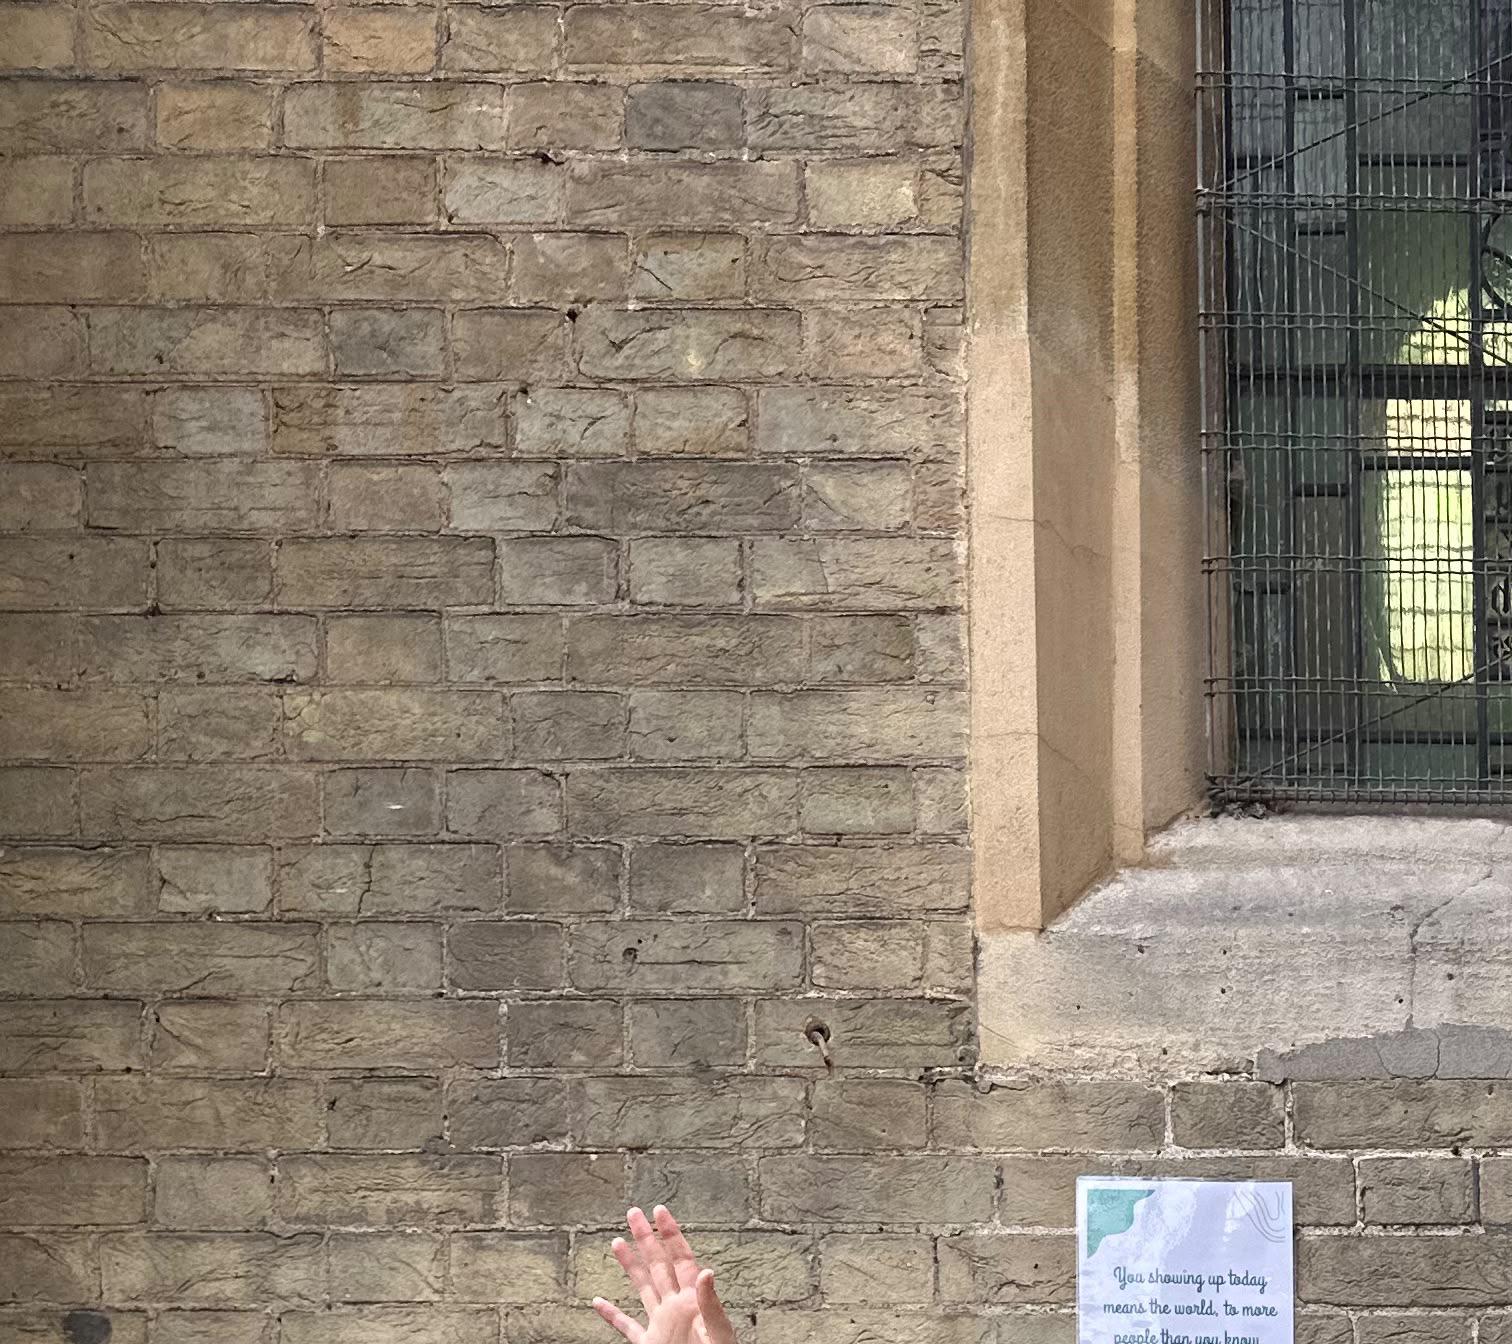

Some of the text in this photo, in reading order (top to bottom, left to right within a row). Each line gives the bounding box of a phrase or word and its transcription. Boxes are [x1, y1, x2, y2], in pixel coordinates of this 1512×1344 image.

[1112, 1266, 1268, 1294] You showing up today
[1103, 1298, 1278, 1317] means the world, to more
